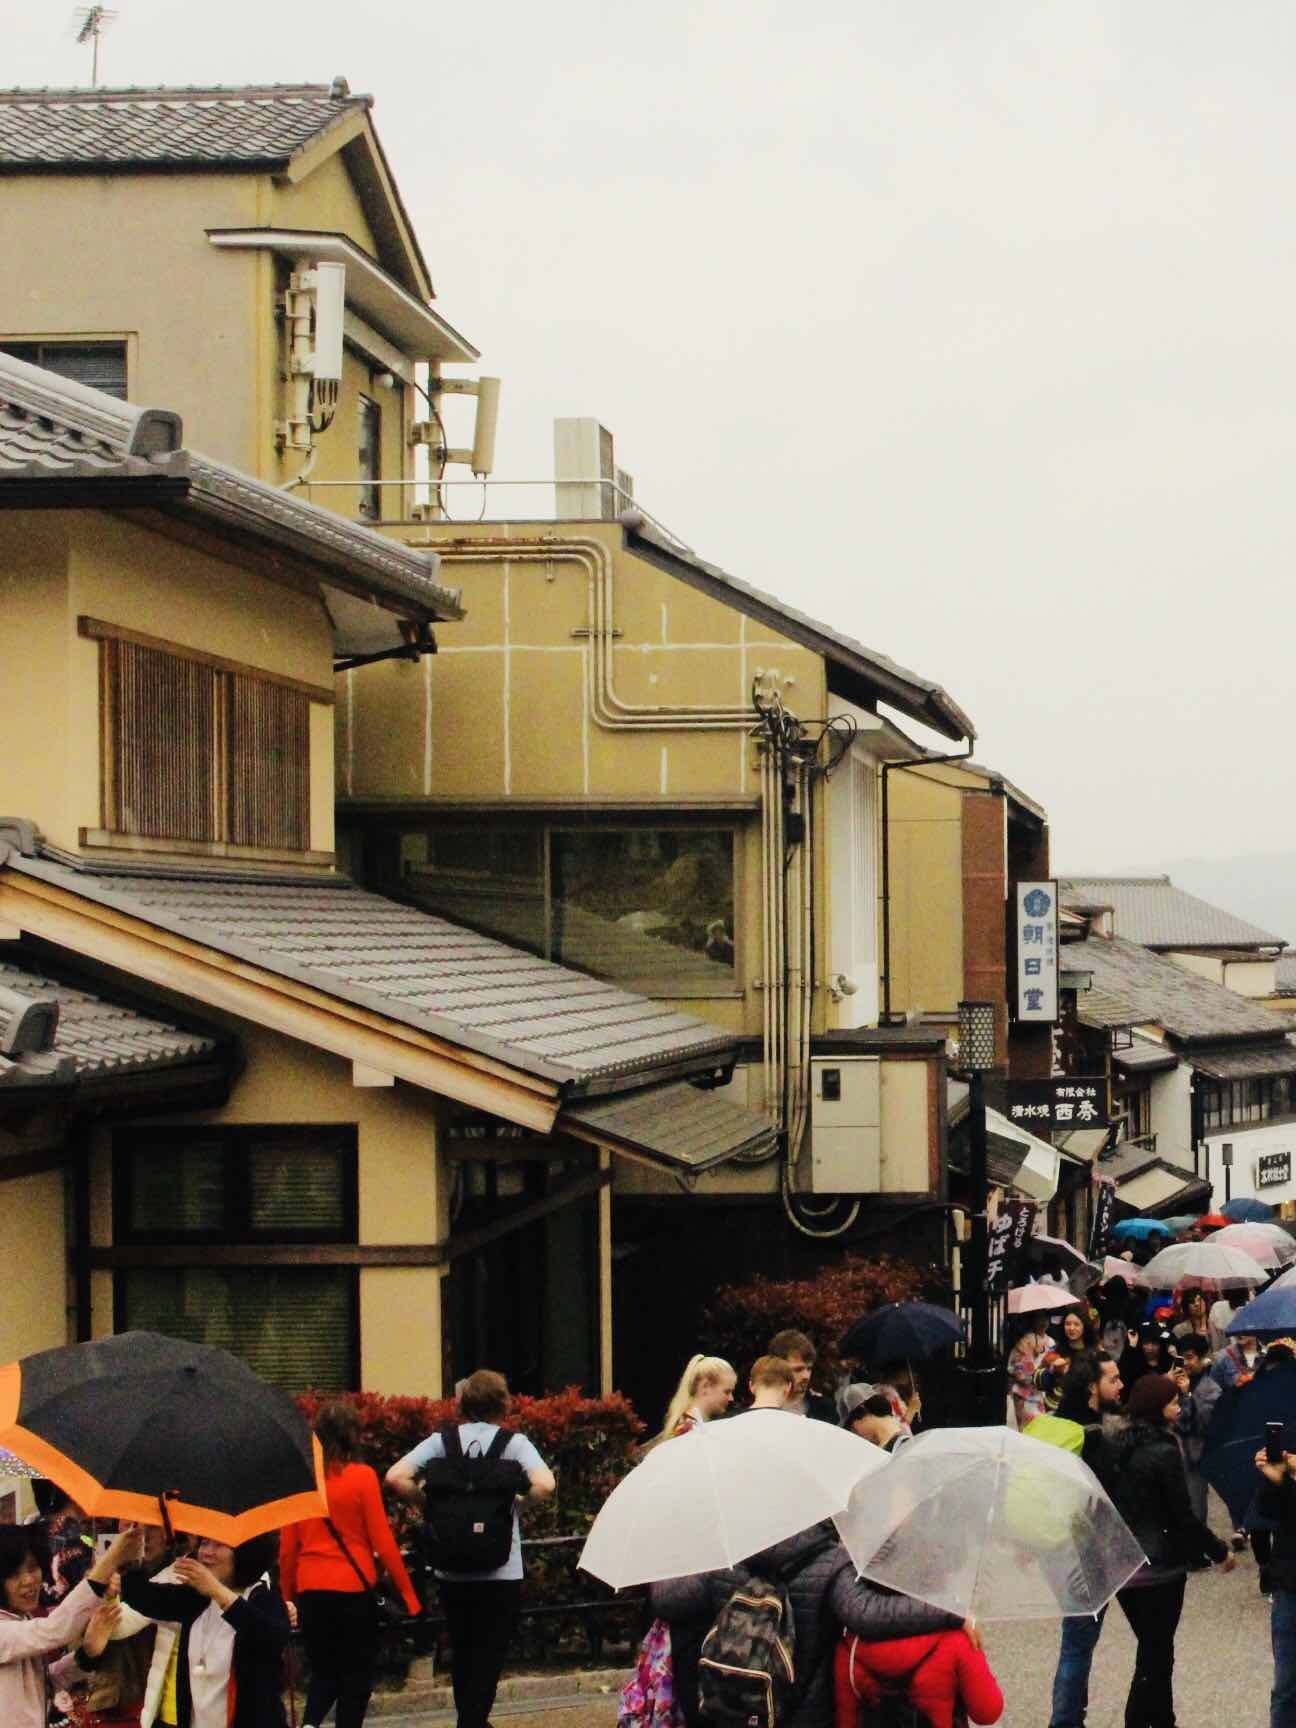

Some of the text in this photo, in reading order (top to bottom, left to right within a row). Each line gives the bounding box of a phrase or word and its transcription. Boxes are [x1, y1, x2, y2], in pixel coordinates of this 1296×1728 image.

[1023, 924, 1043, 1010] 朝日堂
[1011, 1104, 1050, 1118] 清水焼
[1055, 1087, 1097, 1098] 有限会社
[986, 1213, 1013, 1291] ゆばチ
